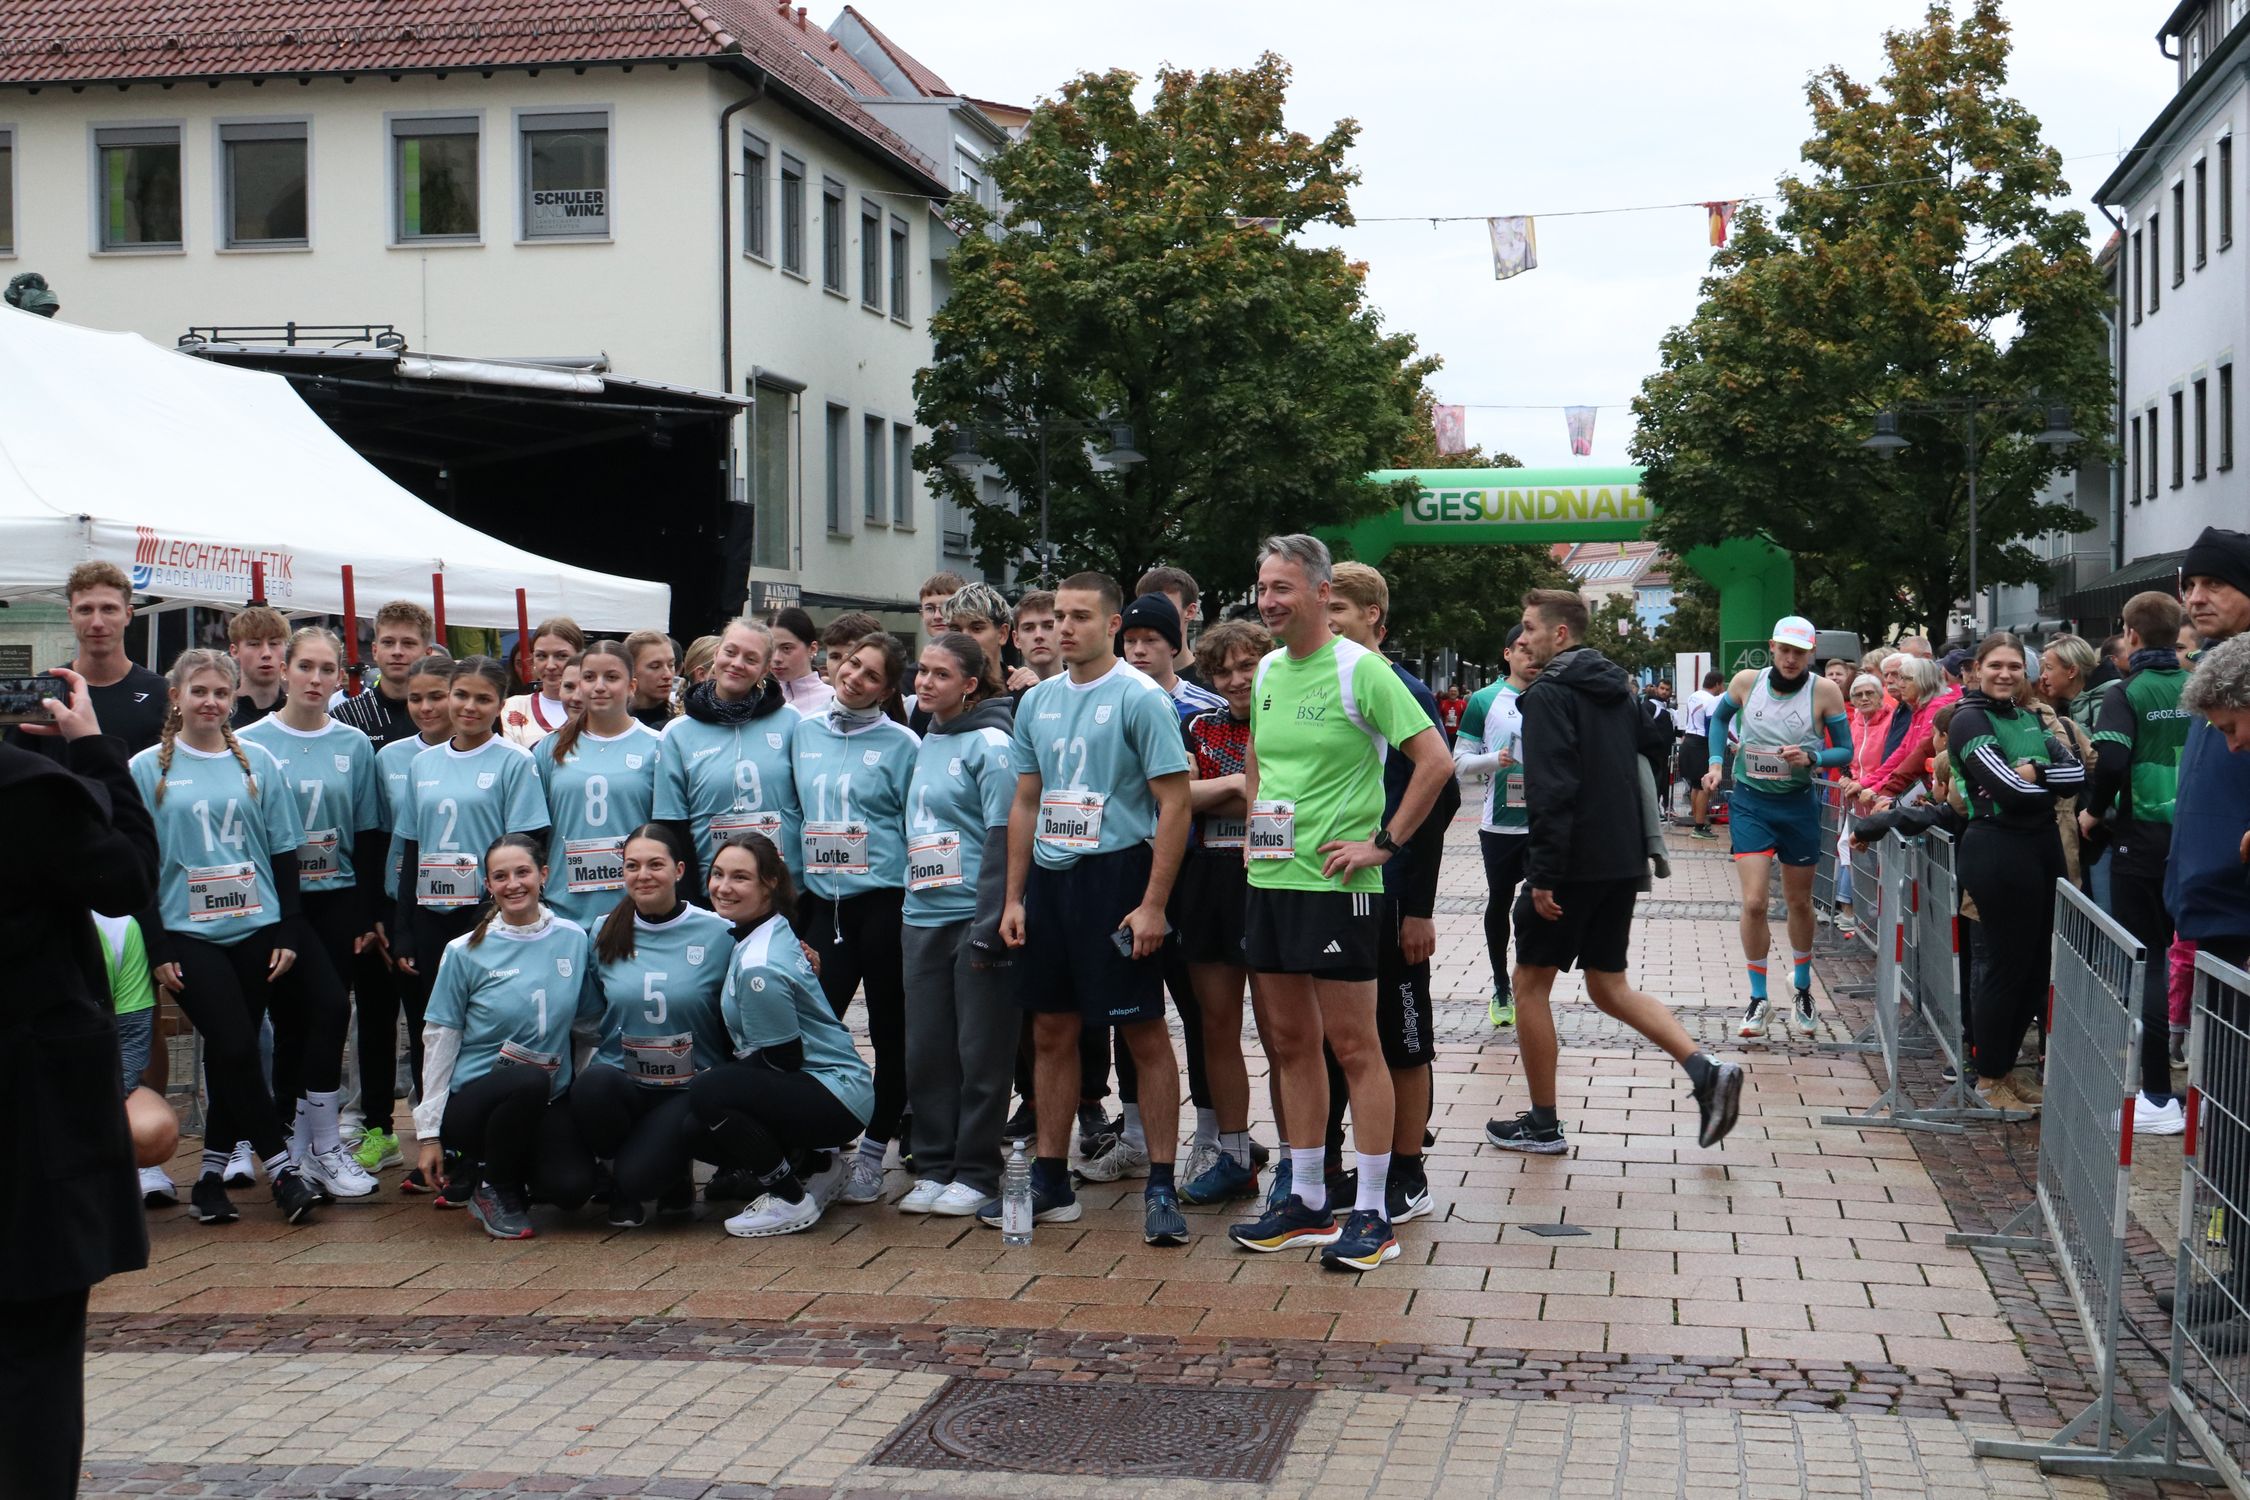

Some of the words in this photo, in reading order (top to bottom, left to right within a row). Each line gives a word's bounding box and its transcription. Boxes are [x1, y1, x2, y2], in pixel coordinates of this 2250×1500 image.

[534, 191, 603, 206] SCHULER
[1296, 705, 1326, 721] BSZ
[1052, 736, 1089, 792] 12
[1754, 762, 1778, 774] Leon
[736, 759, 763, 811] 9
[300, 779, 323, 831] 7
[585, 774, 608, 827] 8
[812, 773, 852, 825] 11
[913, 784, 938, 833] 4
[192, 798, 245, 852] 14
[438, 798, 460, 851] 2
[1045, 818, 1088, 838] Danijel
[1216, 823, 1246, 838] Linu
[712, 831, 728, 840] 412
[805, 838, 817, 846] 417
[567, 856, 583, 865] 399
[911, 863, 944, 880] Fiona
[190, 884, 207, 893] 408
[430, 880, 455, 895] Kim
[205, 891, 247, 909] Emily
[489, 968, 520, 978] Kempa
[644, 972, 668, 1025] 5
[531, 988, 547, 1041] 1
[1109, 1006, 1140, 1015] uhlsport
[1399, 982, 1421, 1053] uhlsport
[498, 1056, 516, 1067] 397
[637, 1060, 676, 1076] Tiara
